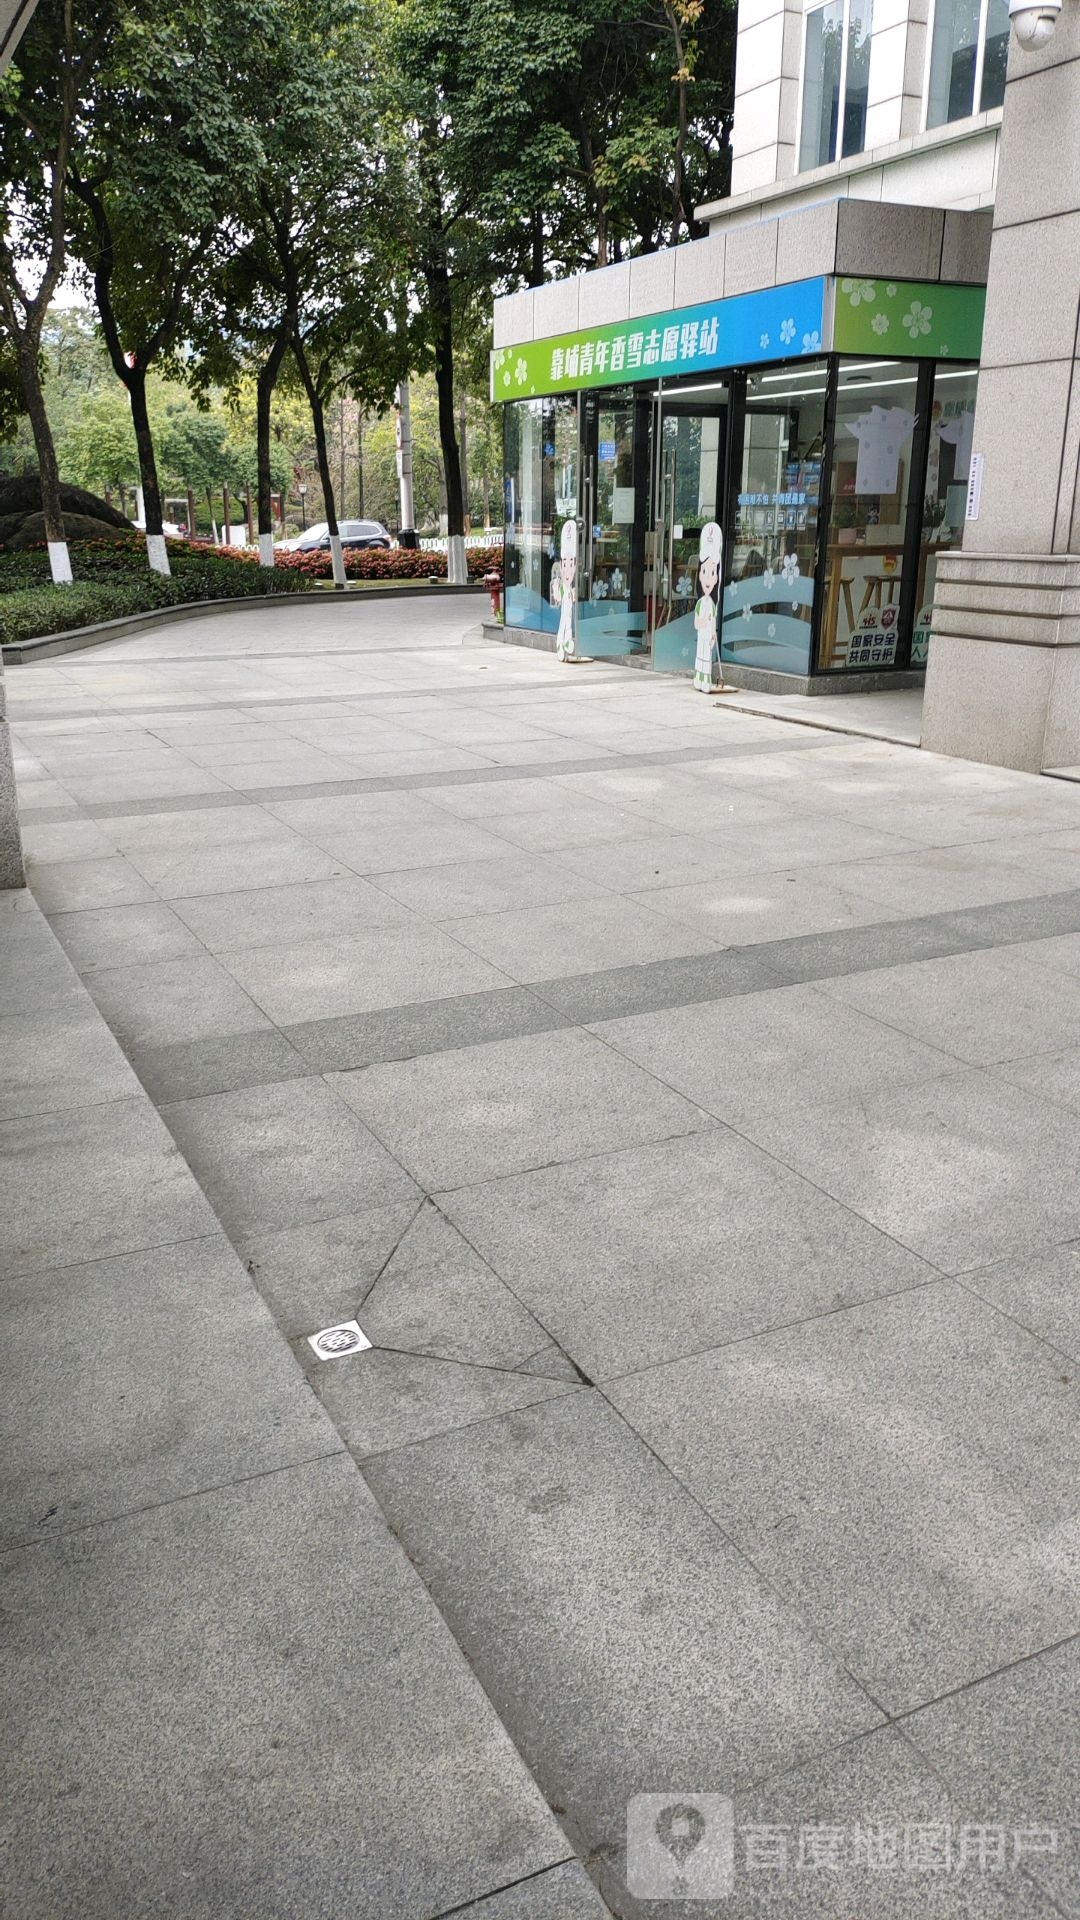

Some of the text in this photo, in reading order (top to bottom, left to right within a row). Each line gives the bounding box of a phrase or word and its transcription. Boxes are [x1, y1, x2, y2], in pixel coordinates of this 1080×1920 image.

[850, 632, 896, 648] 国家安全
[849, 647, 893, 663] 共同守护
